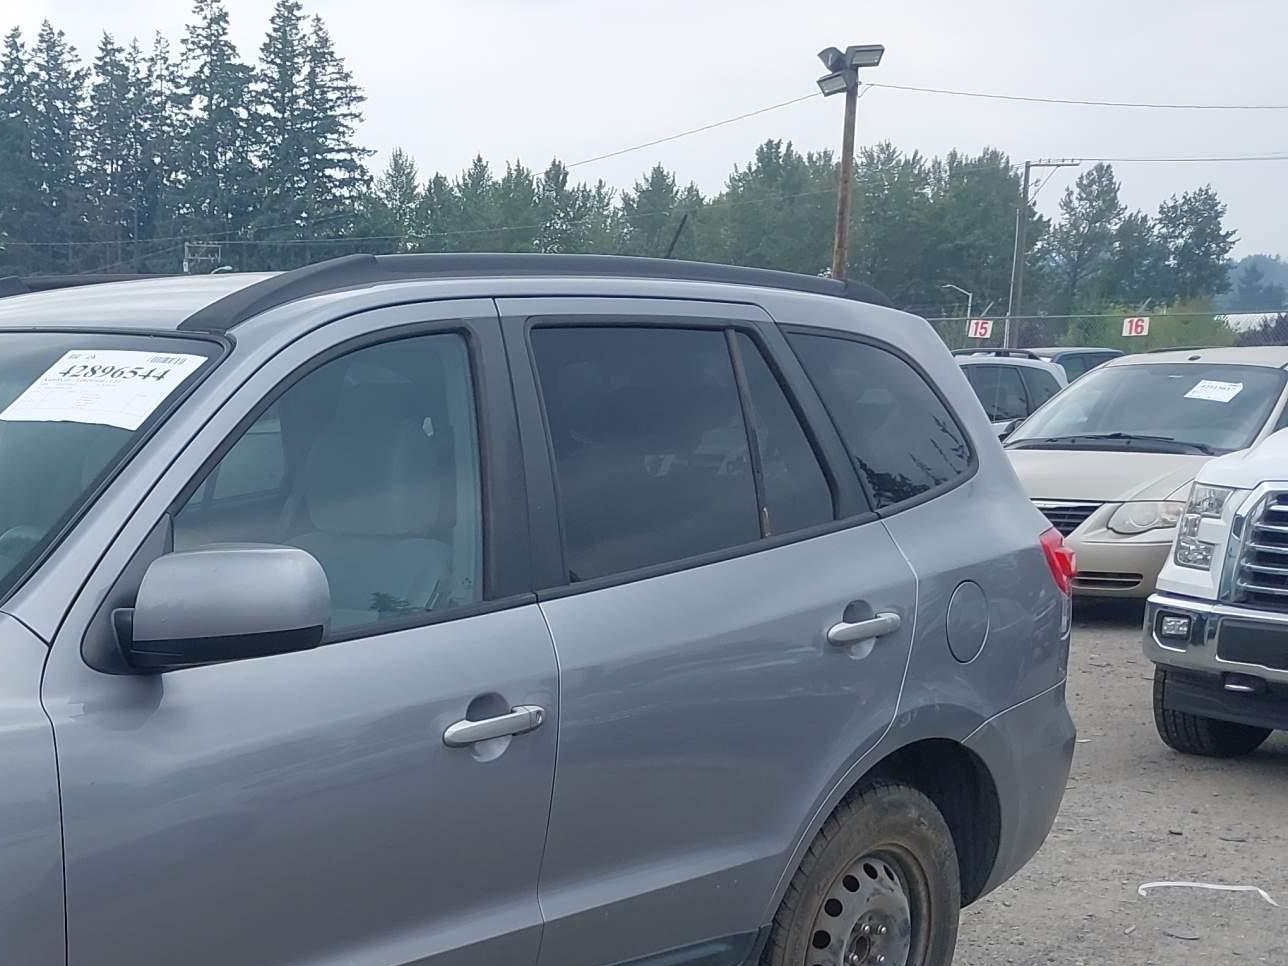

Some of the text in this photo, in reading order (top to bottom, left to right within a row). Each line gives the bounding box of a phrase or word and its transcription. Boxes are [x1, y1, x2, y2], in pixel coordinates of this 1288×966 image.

[973, 321, 989, 336] 15
[1128, 318, 1145, 335] 16
[58, 364, 171, 381] 42896544
